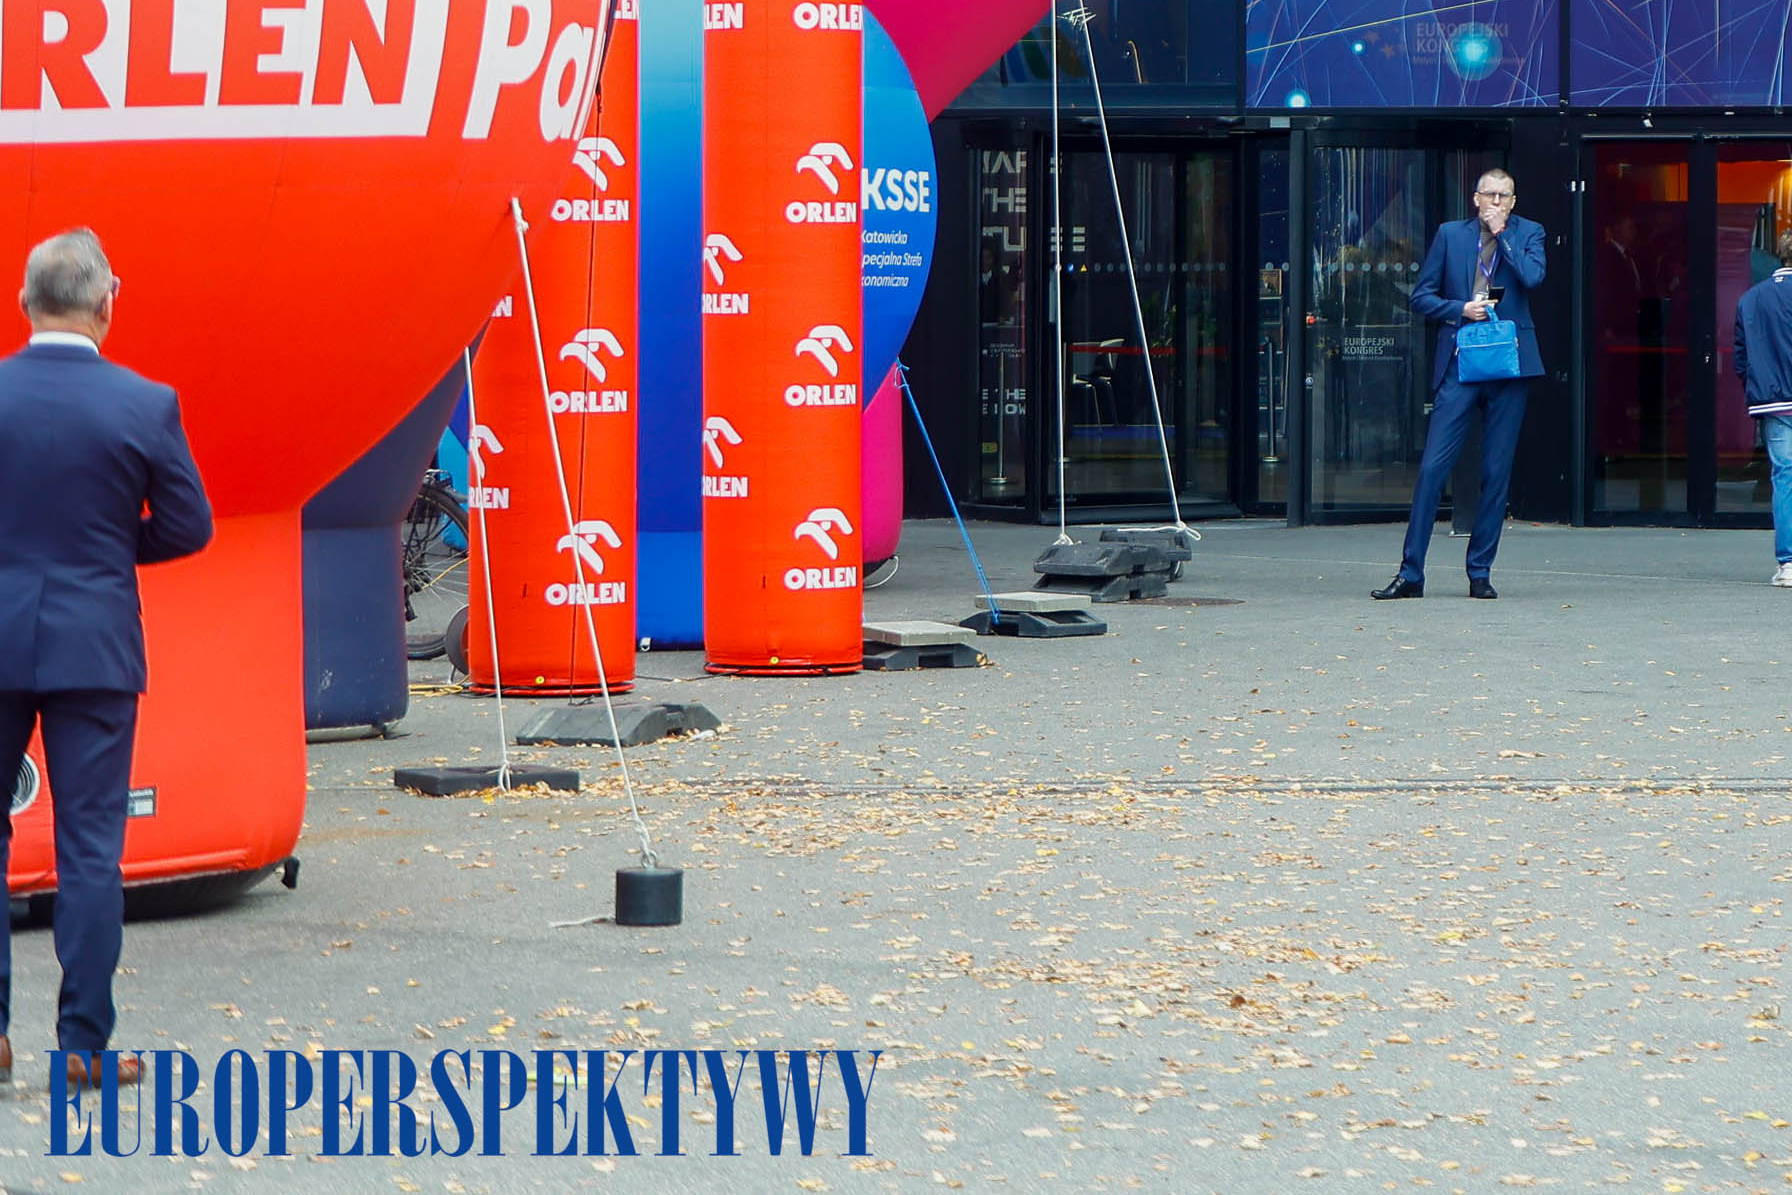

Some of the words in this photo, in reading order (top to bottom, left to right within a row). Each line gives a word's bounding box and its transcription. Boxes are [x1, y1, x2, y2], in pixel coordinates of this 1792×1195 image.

[703, 3, 744, 30] LEN
[793, 2, 862, 31] ORLE
[862, 167, 931, 213] KSSE
[550, 199, 630, 222] ORLEN
[785, 201, 858, 224] ORLEN
[861, 251, 902, 269] pecjalna
[861, 273, 909, 287] onomiczna
[702, 293, 749, 315] RLEN
[550, 390, 628, 414] ORLEN
[784, 384, 857, 407] ORLEN
[469, 486, 510, 510] RLEN
[702, 476, 748, 497] RLEN
[784, 566, 857, 590] ORLEN
[545, 581, 626, 606] ORLEN
